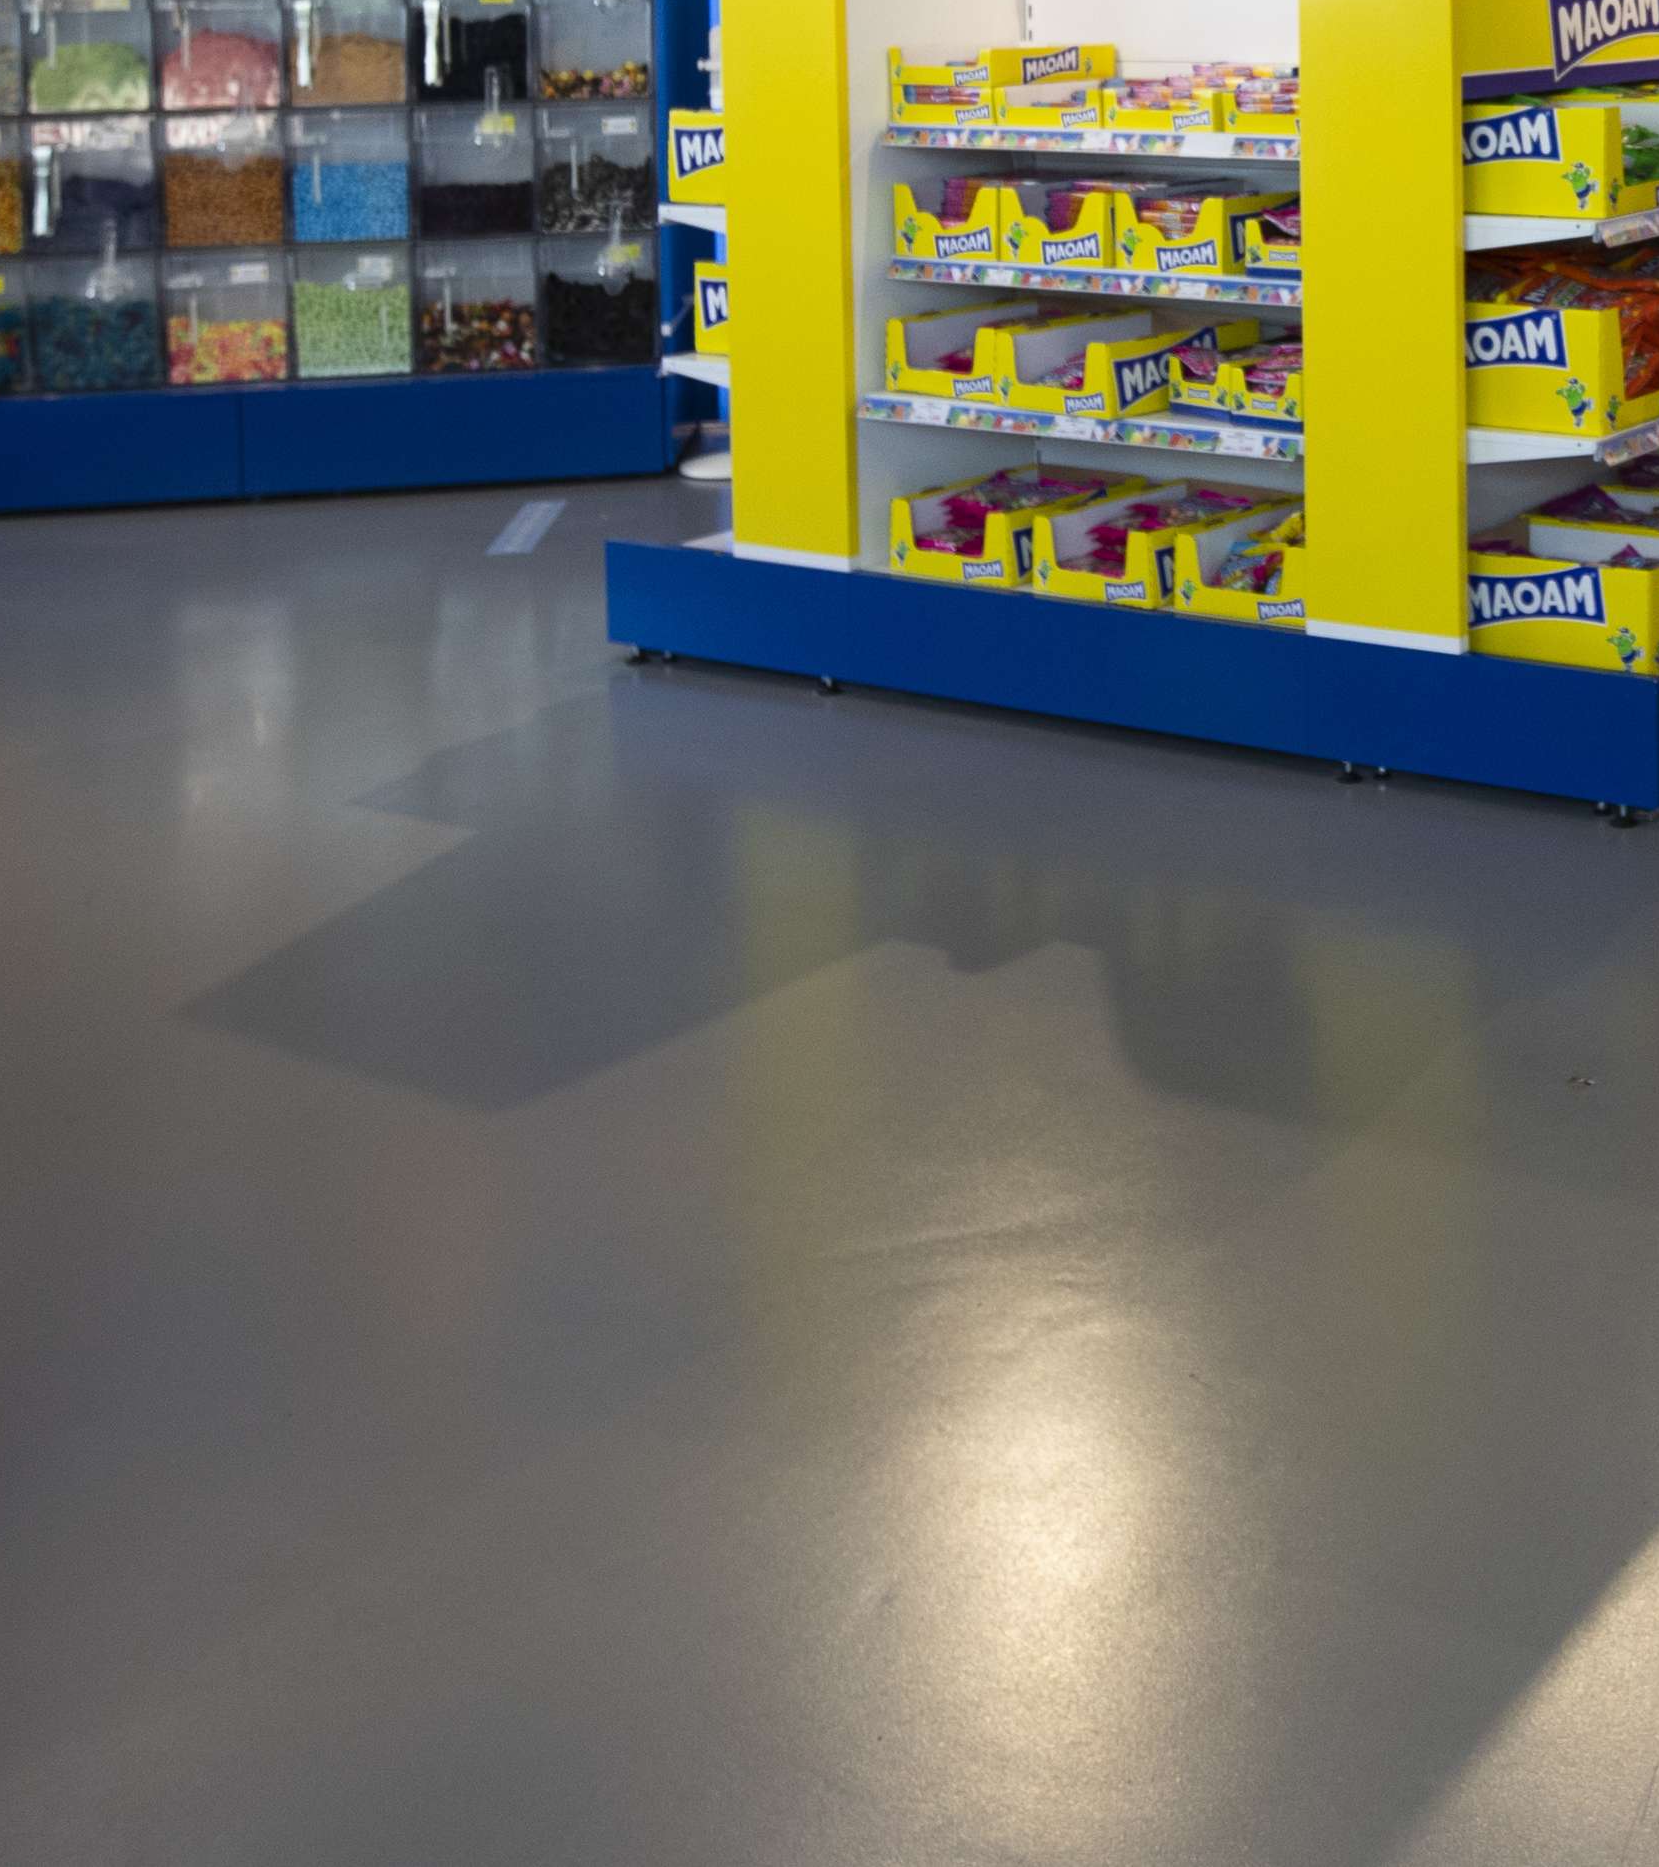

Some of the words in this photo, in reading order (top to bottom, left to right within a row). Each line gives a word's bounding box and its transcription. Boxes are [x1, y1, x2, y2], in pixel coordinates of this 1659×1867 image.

[1024, 49, 1078, 82] MAOAM
[936, 228, 990, 257] MAOAM
[1043, 234, 1099, 262] MAOAM
[1157, 242, 1215, 269] MAOAM
